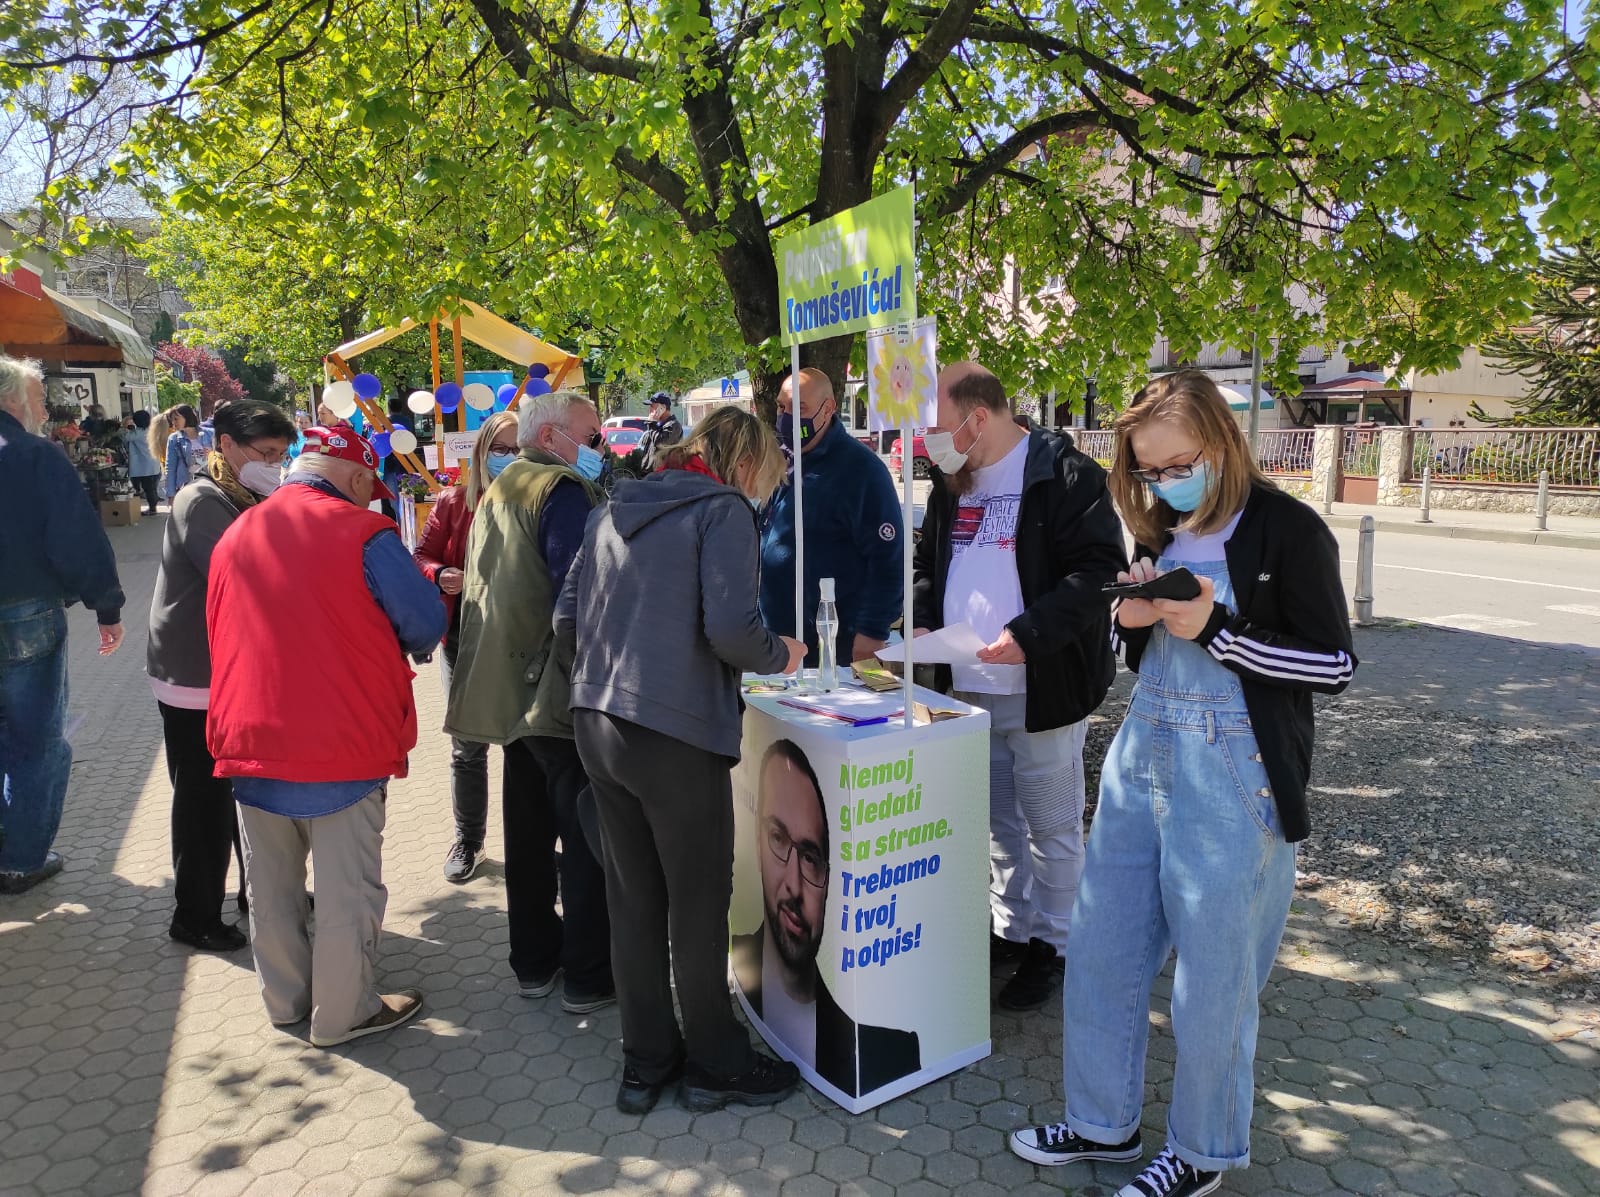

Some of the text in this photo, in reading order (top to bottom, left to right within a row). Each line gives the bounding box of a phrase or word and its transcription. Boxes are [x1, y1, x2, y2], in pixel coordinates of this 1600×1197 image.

[846, 227, 868, 267] za
[787, 265, 902, 334] Tomaševića!
[839, 750, 914, 790] Nemoj
[839, 784, 922, 832] gledati
[840, 818, 953, 862] sa strane.
[841, 855, 941, 898] Trebamo
[841, 894, 897, 933] i tvoj
[841, 923, 922, 973] potpis!
